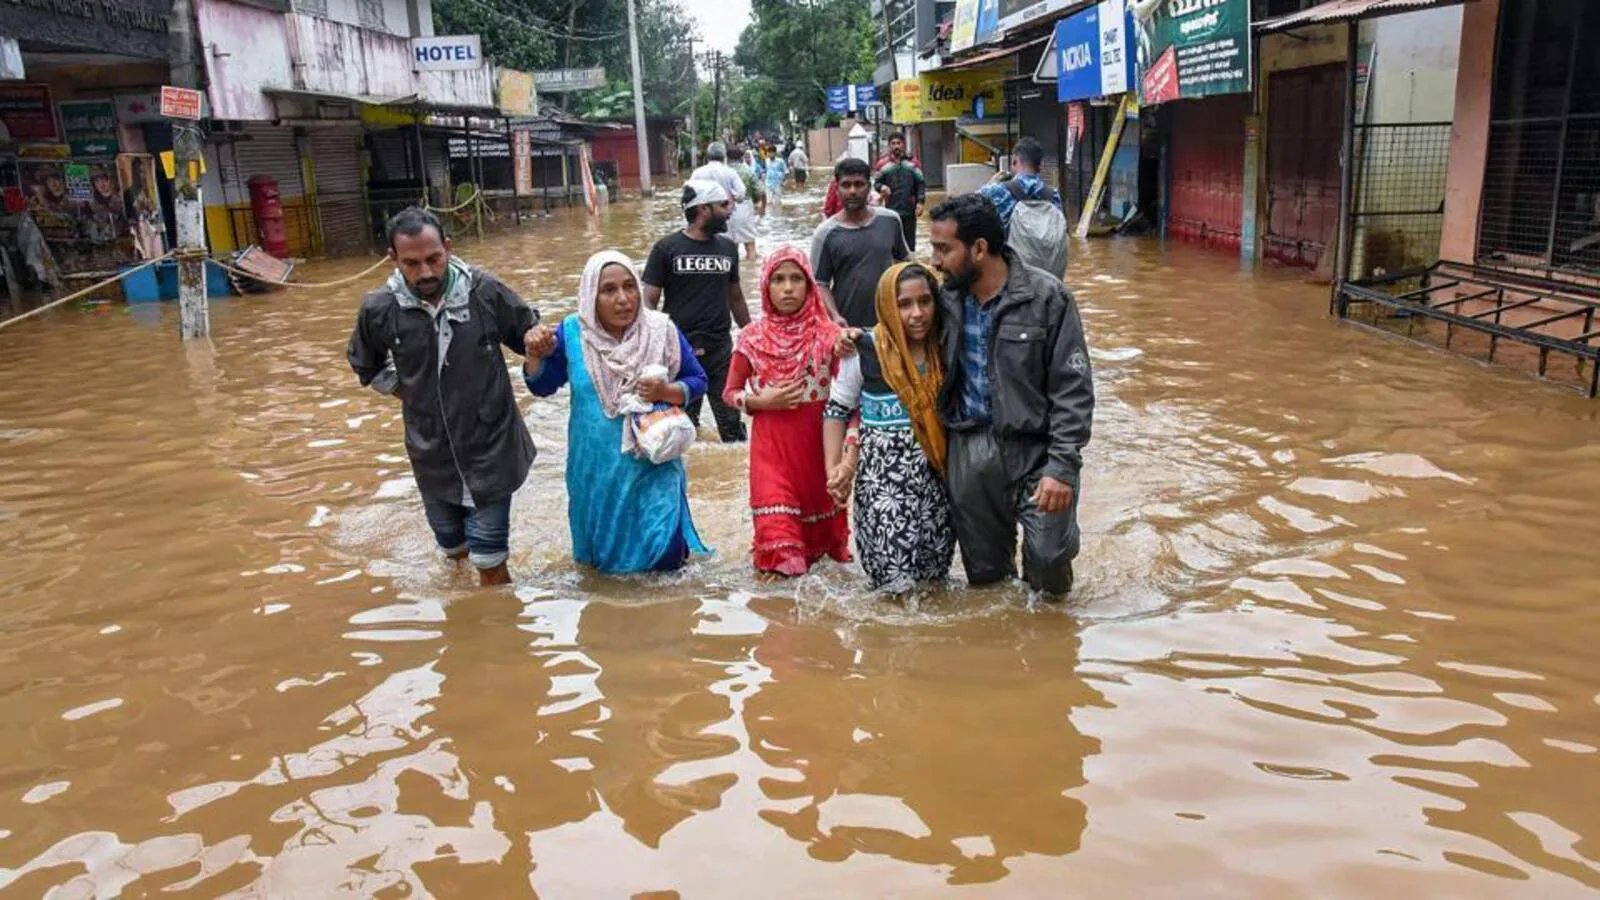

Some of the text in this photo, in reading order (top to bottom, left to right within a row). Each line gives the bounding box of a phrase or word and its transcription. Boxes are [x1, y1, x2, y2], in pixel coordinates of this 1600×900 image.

[415, 45, 476, 61] HOTEL
[1062, 42, 1092, 72] NOKIA
[676, 256, 732, 272] LEGEND
